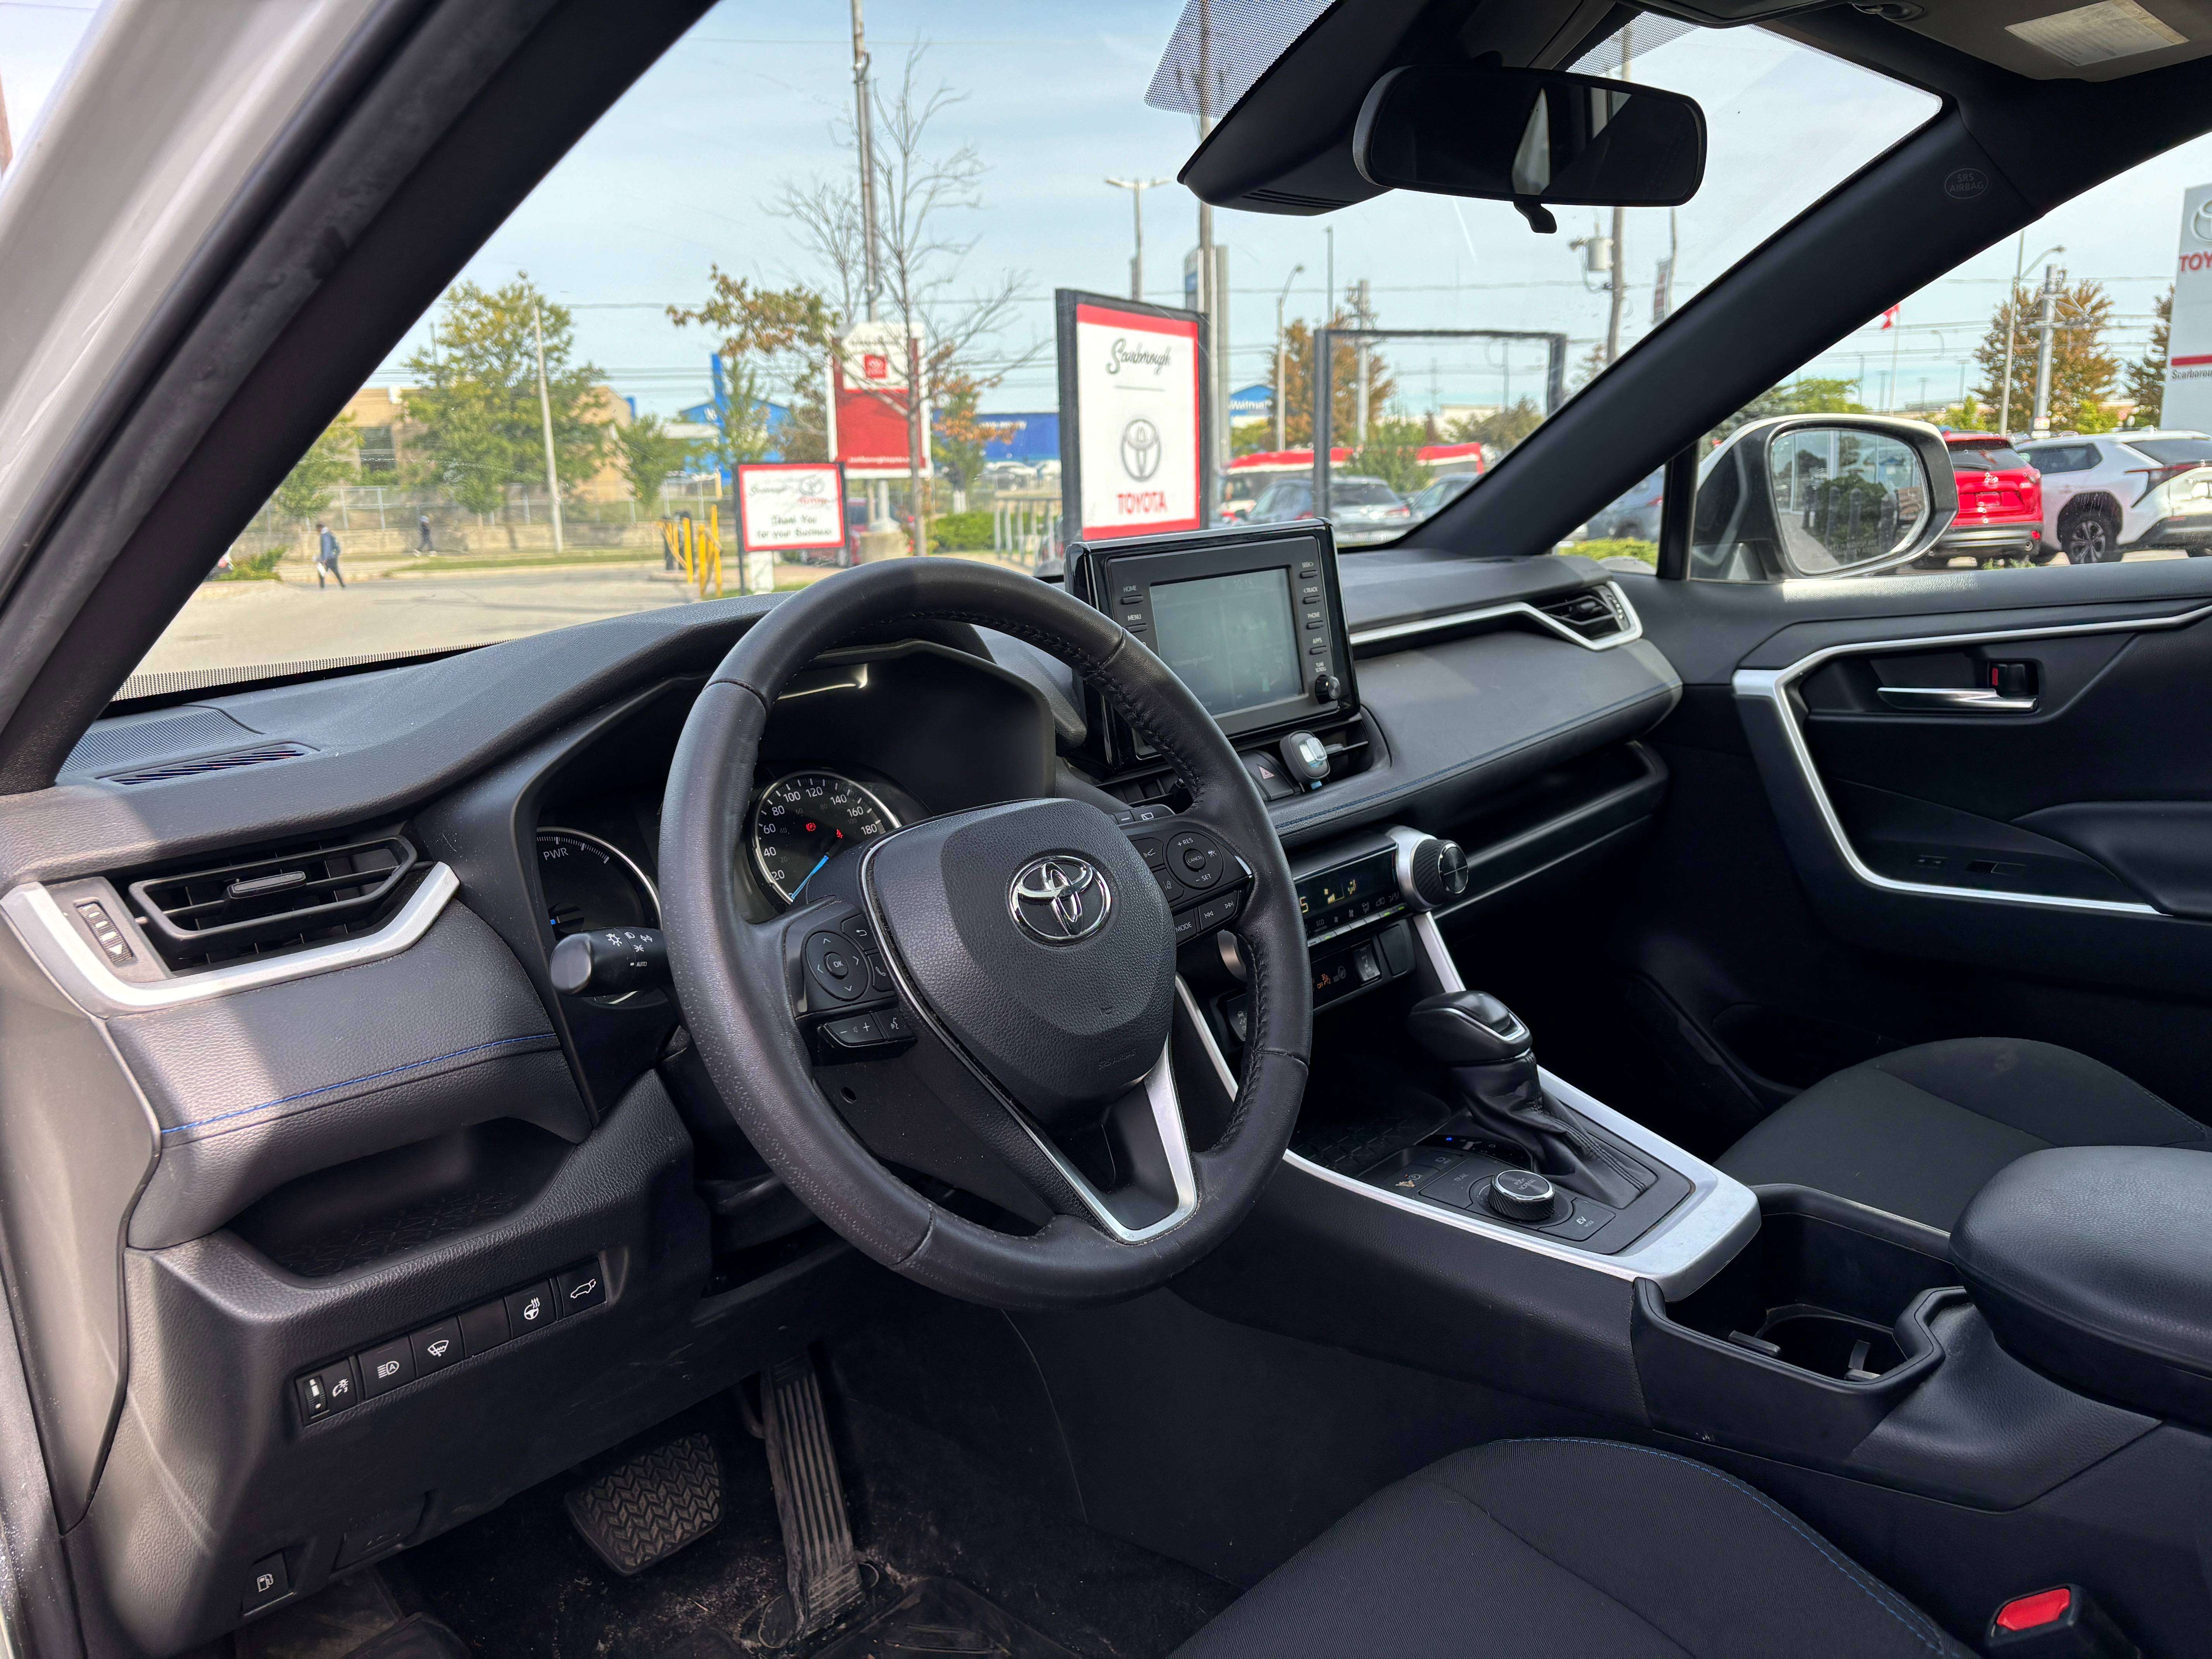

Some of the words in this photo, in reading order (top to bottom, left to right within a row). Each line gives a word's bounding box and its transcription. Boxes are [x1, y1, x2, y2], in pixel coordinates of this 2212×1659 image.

[1958, 173, 1974, 182] SRS
[1949, 182, 1984, 192] AIRBAG
[1106, 338, 1171, 375] Scarborough
[1117, 491, 1168, 514] TOYOTA
[783, 791, 801, 802] 100
[806, 787, 823, 798] 120
[830, 794, 847, 805] 140
[772, 805, 785, 816] 80
[847, 806, 864, 817] 160
[764, 823, 776, 834] 60
[861, 823, 878, 835] 180
[543, 847, 568, 860] PWR
[764, 847, 776, 857] 40
[1188, 855, 1203, 864] CANCEL
[772, 869, 785, 881] 20
[1175, 922, 1192, 933] MODE
[1576, 1216, 1587, 1224] EV
